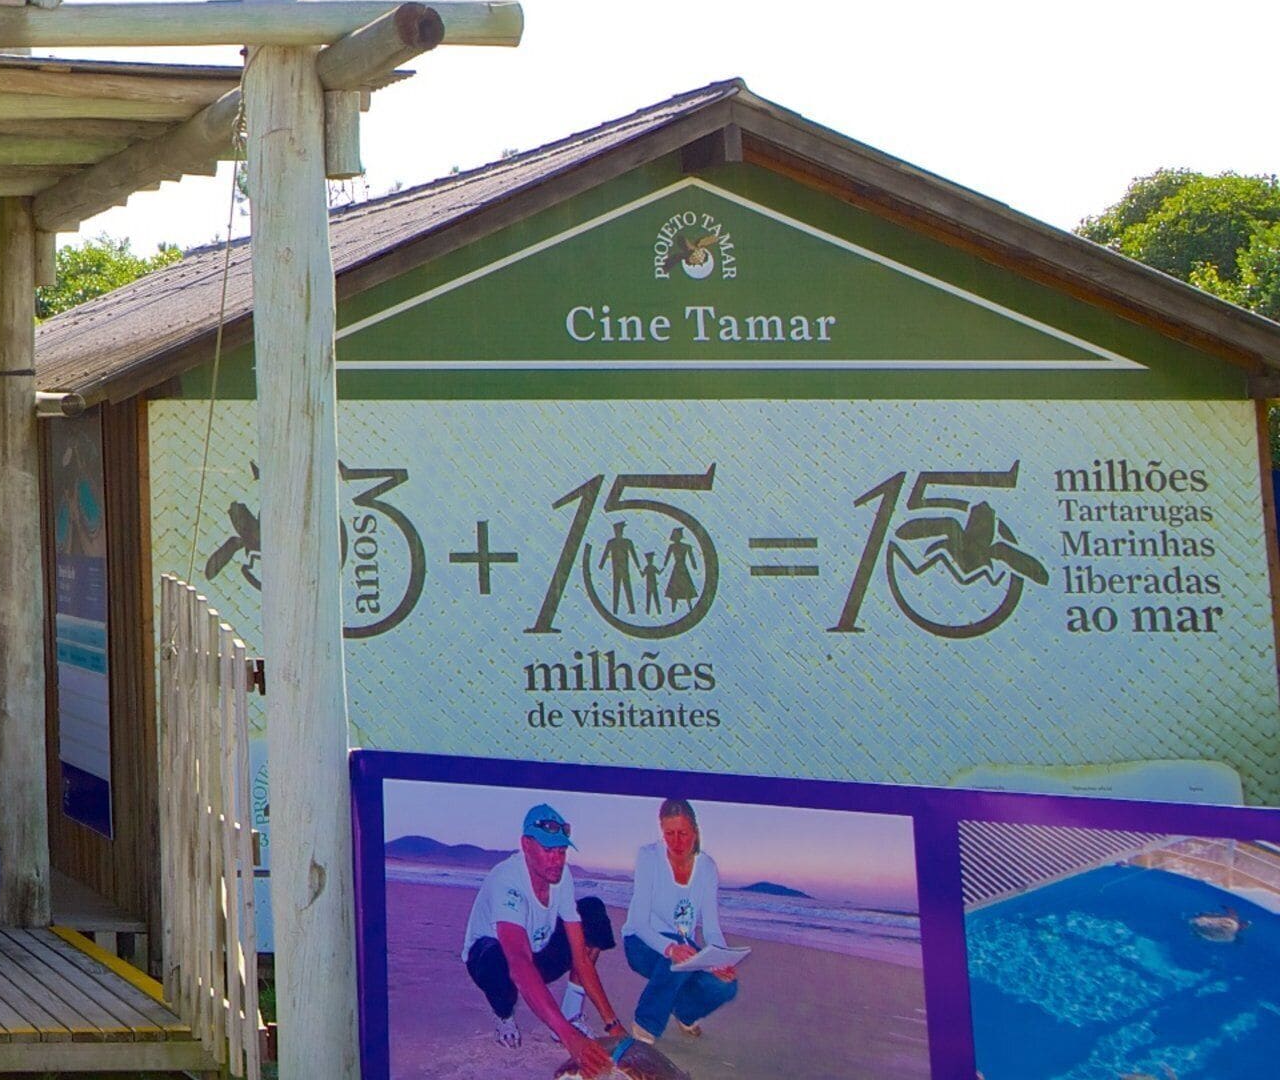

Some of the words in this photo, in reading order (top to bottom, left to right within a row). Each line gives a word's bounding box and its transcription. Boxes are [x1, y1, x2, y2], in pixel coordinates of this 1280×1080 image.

[654, 211, 696, 279] PROJETO
[701, 213, 737, 279] TAMAR
[566, 305, 671, 341] Cine
[686, 305, 836, 341] Tamar
[1055, 459, 1209, 494] milhões
[1057, 499, 1214, 526] Tartarugas
[523, 463, 720, 639] 15
[1060, 529, 1216, 558] Marinhas
[352, 514, 381, 614] anos
[1063, 564, 1222, 596] liberadas
[1066, 605, 1119, 633] ao
[1131, 605, 1224, 634] mar
[524, 650, 716, 693] milhões
[527, 701, 564, 729] de
[572, 701, 722, 729] visitantes
